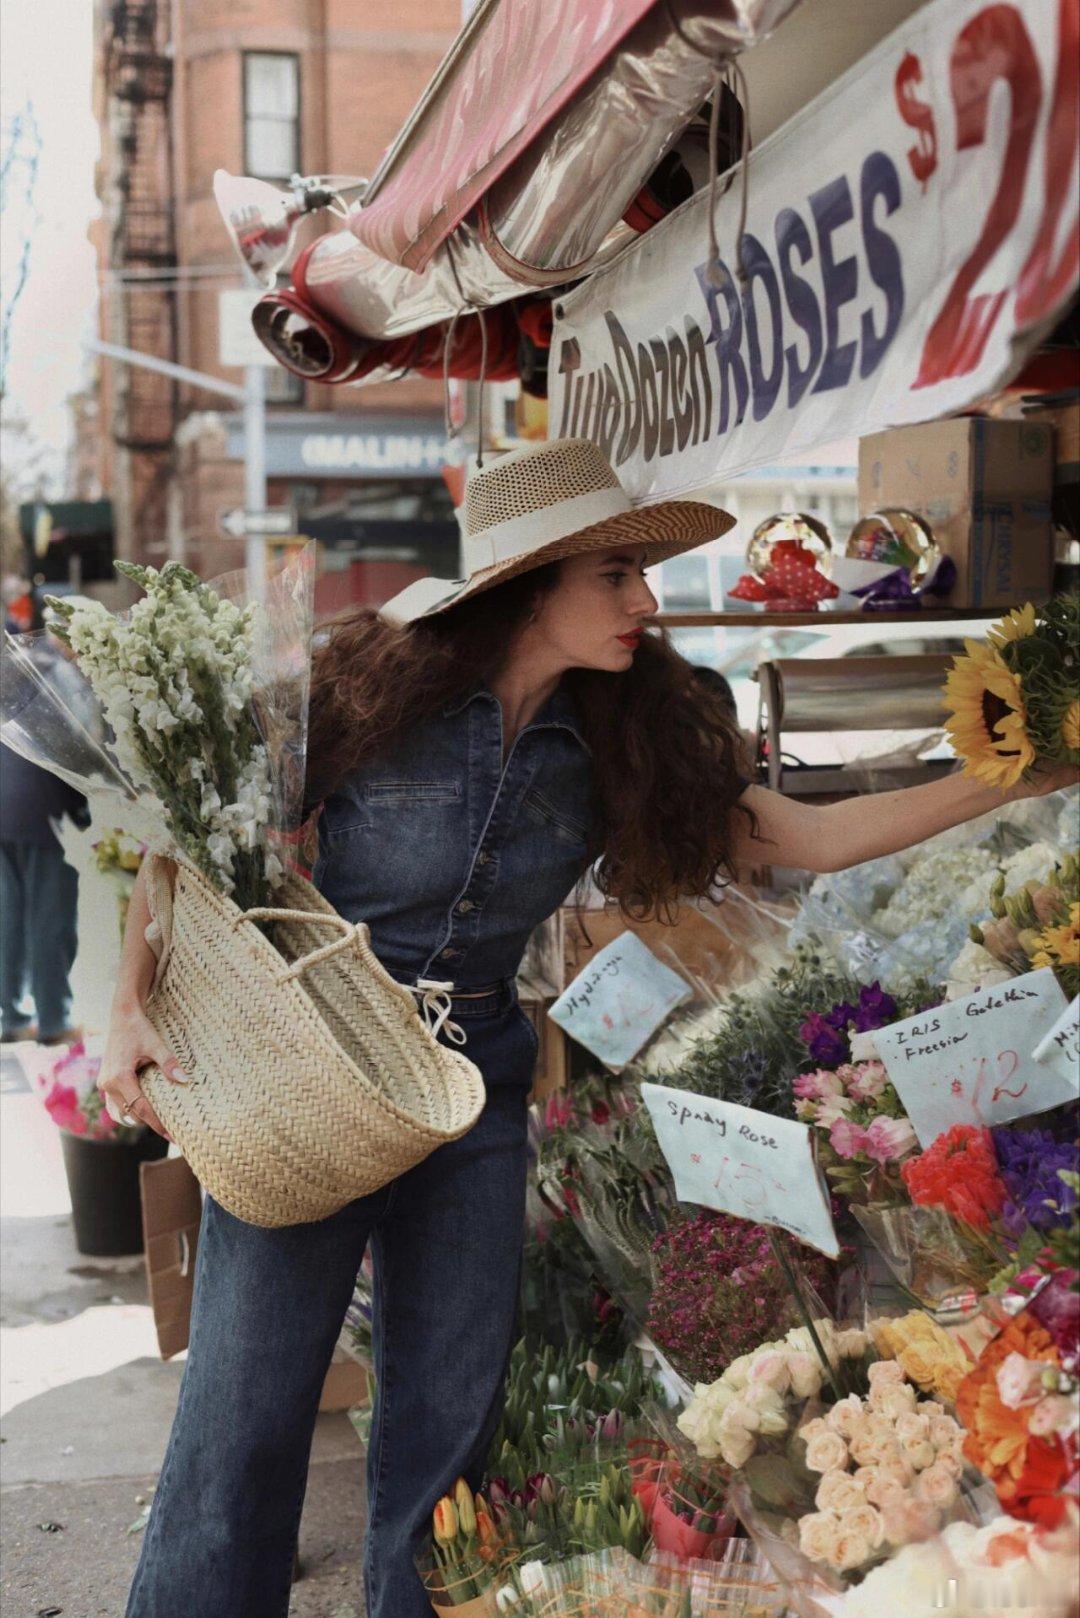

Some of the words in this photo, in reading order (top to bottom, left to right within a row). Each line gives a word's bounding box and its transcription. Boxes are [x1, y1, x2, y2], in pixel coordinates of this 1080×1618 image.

[604, 310, 712, 467] Dozen
[694, 150, 905, 435] ROSES
[905, 1032, 968, 1061] Freesia
[667, 1100, 726, 1137] Spray
[738, 1124, 778, 1149] Rose
